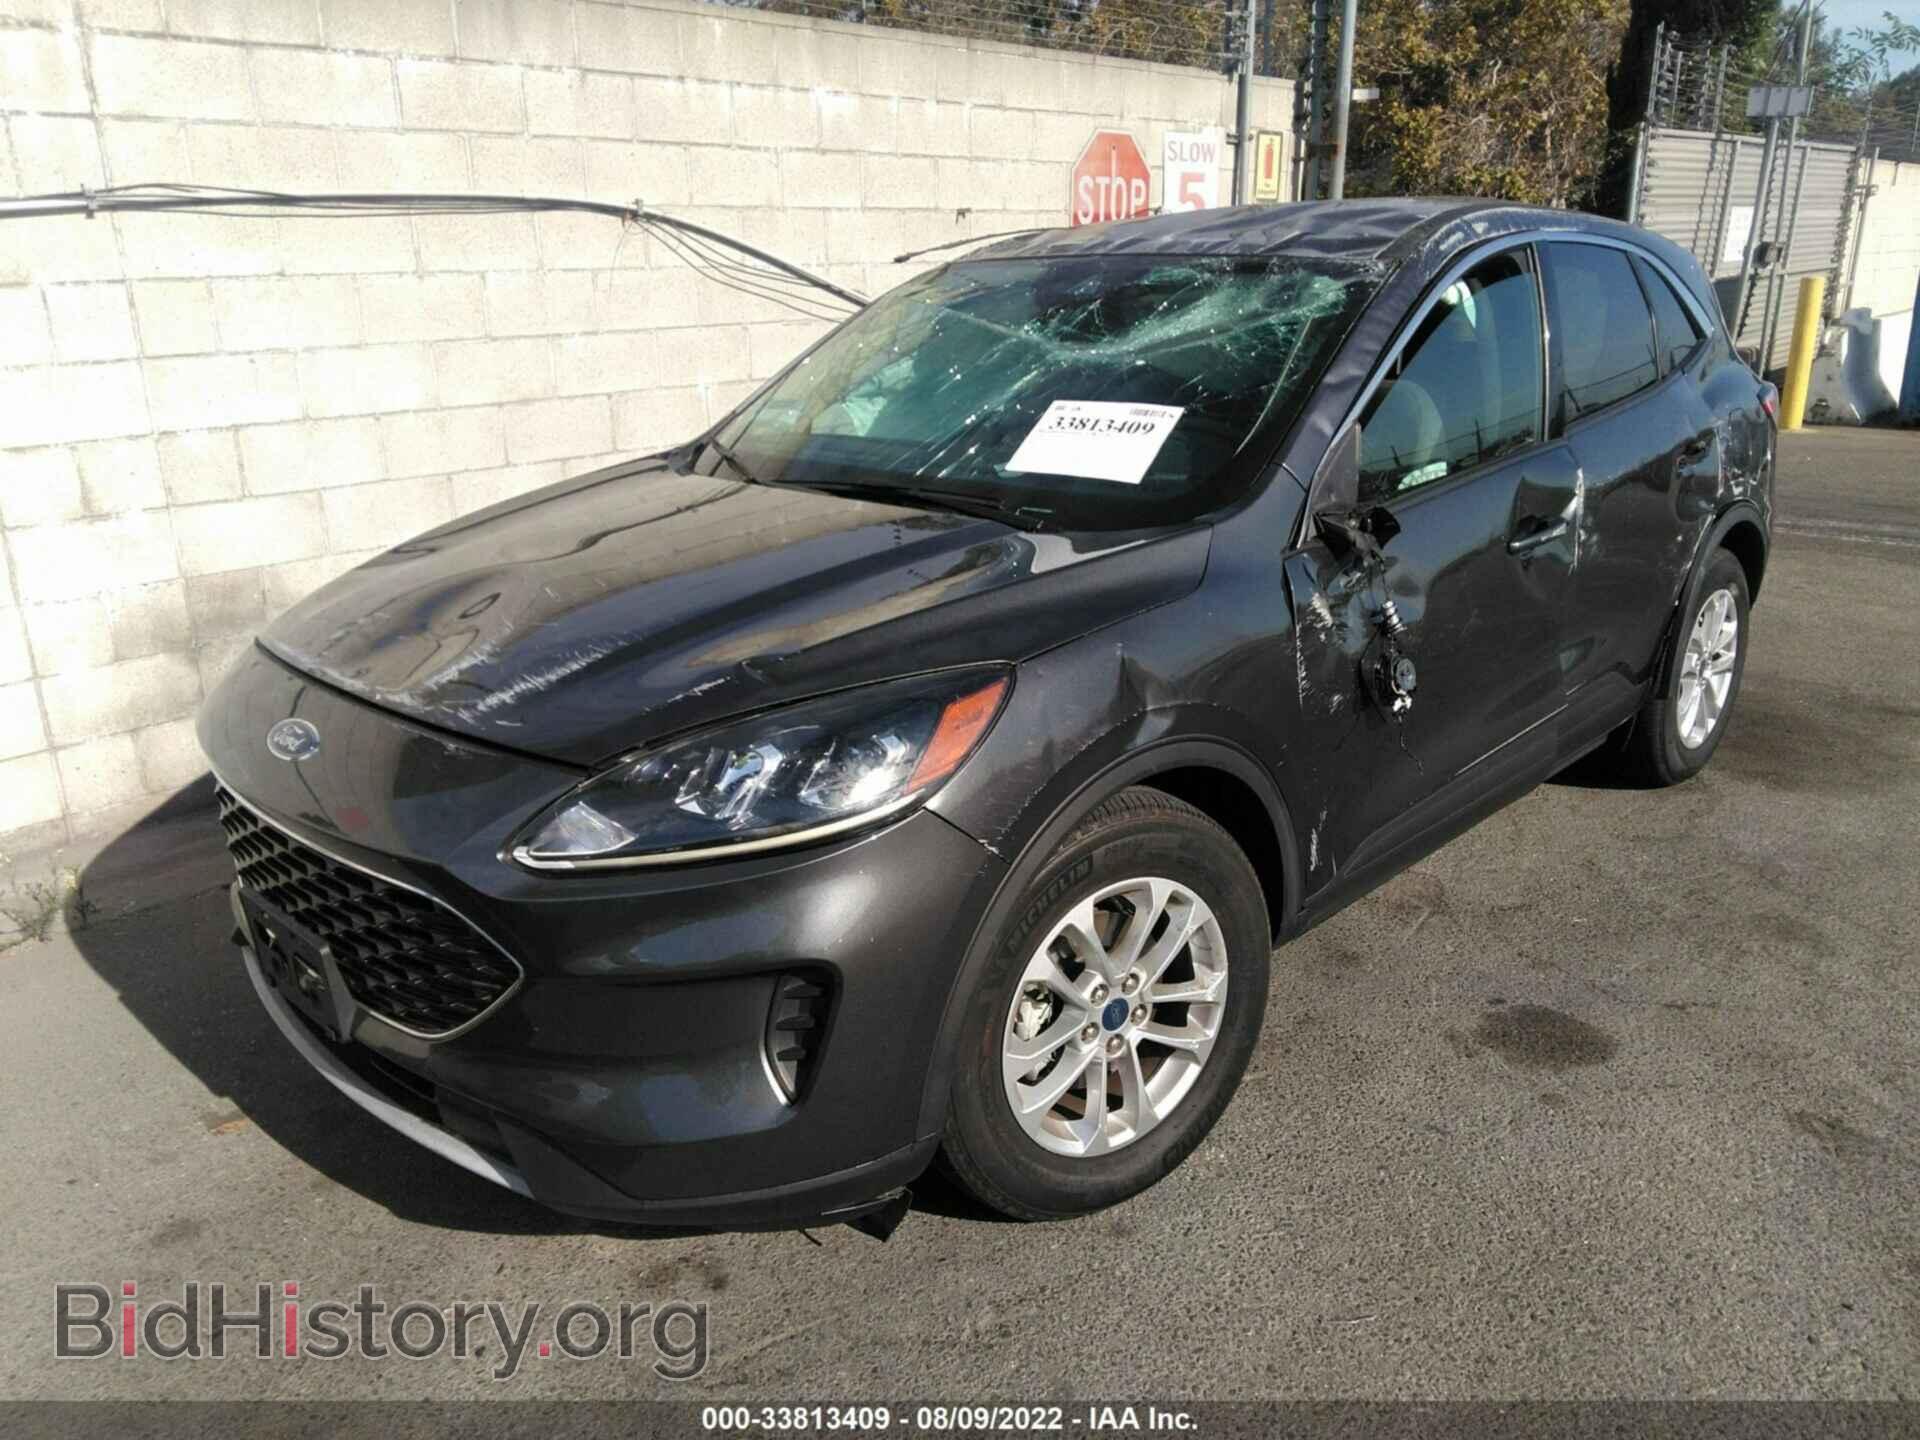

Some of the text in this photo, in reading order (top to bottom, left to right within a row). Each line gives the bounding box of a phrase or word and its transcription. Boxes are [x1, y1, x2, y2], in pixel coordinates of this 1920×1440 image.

[1167, 139, 1217, 164] SLOW
[1077, 174, 1146, 226] STOP
[1178, 170, 1206, 209] 5
[1048, 415, 1156, 435] 33813409
